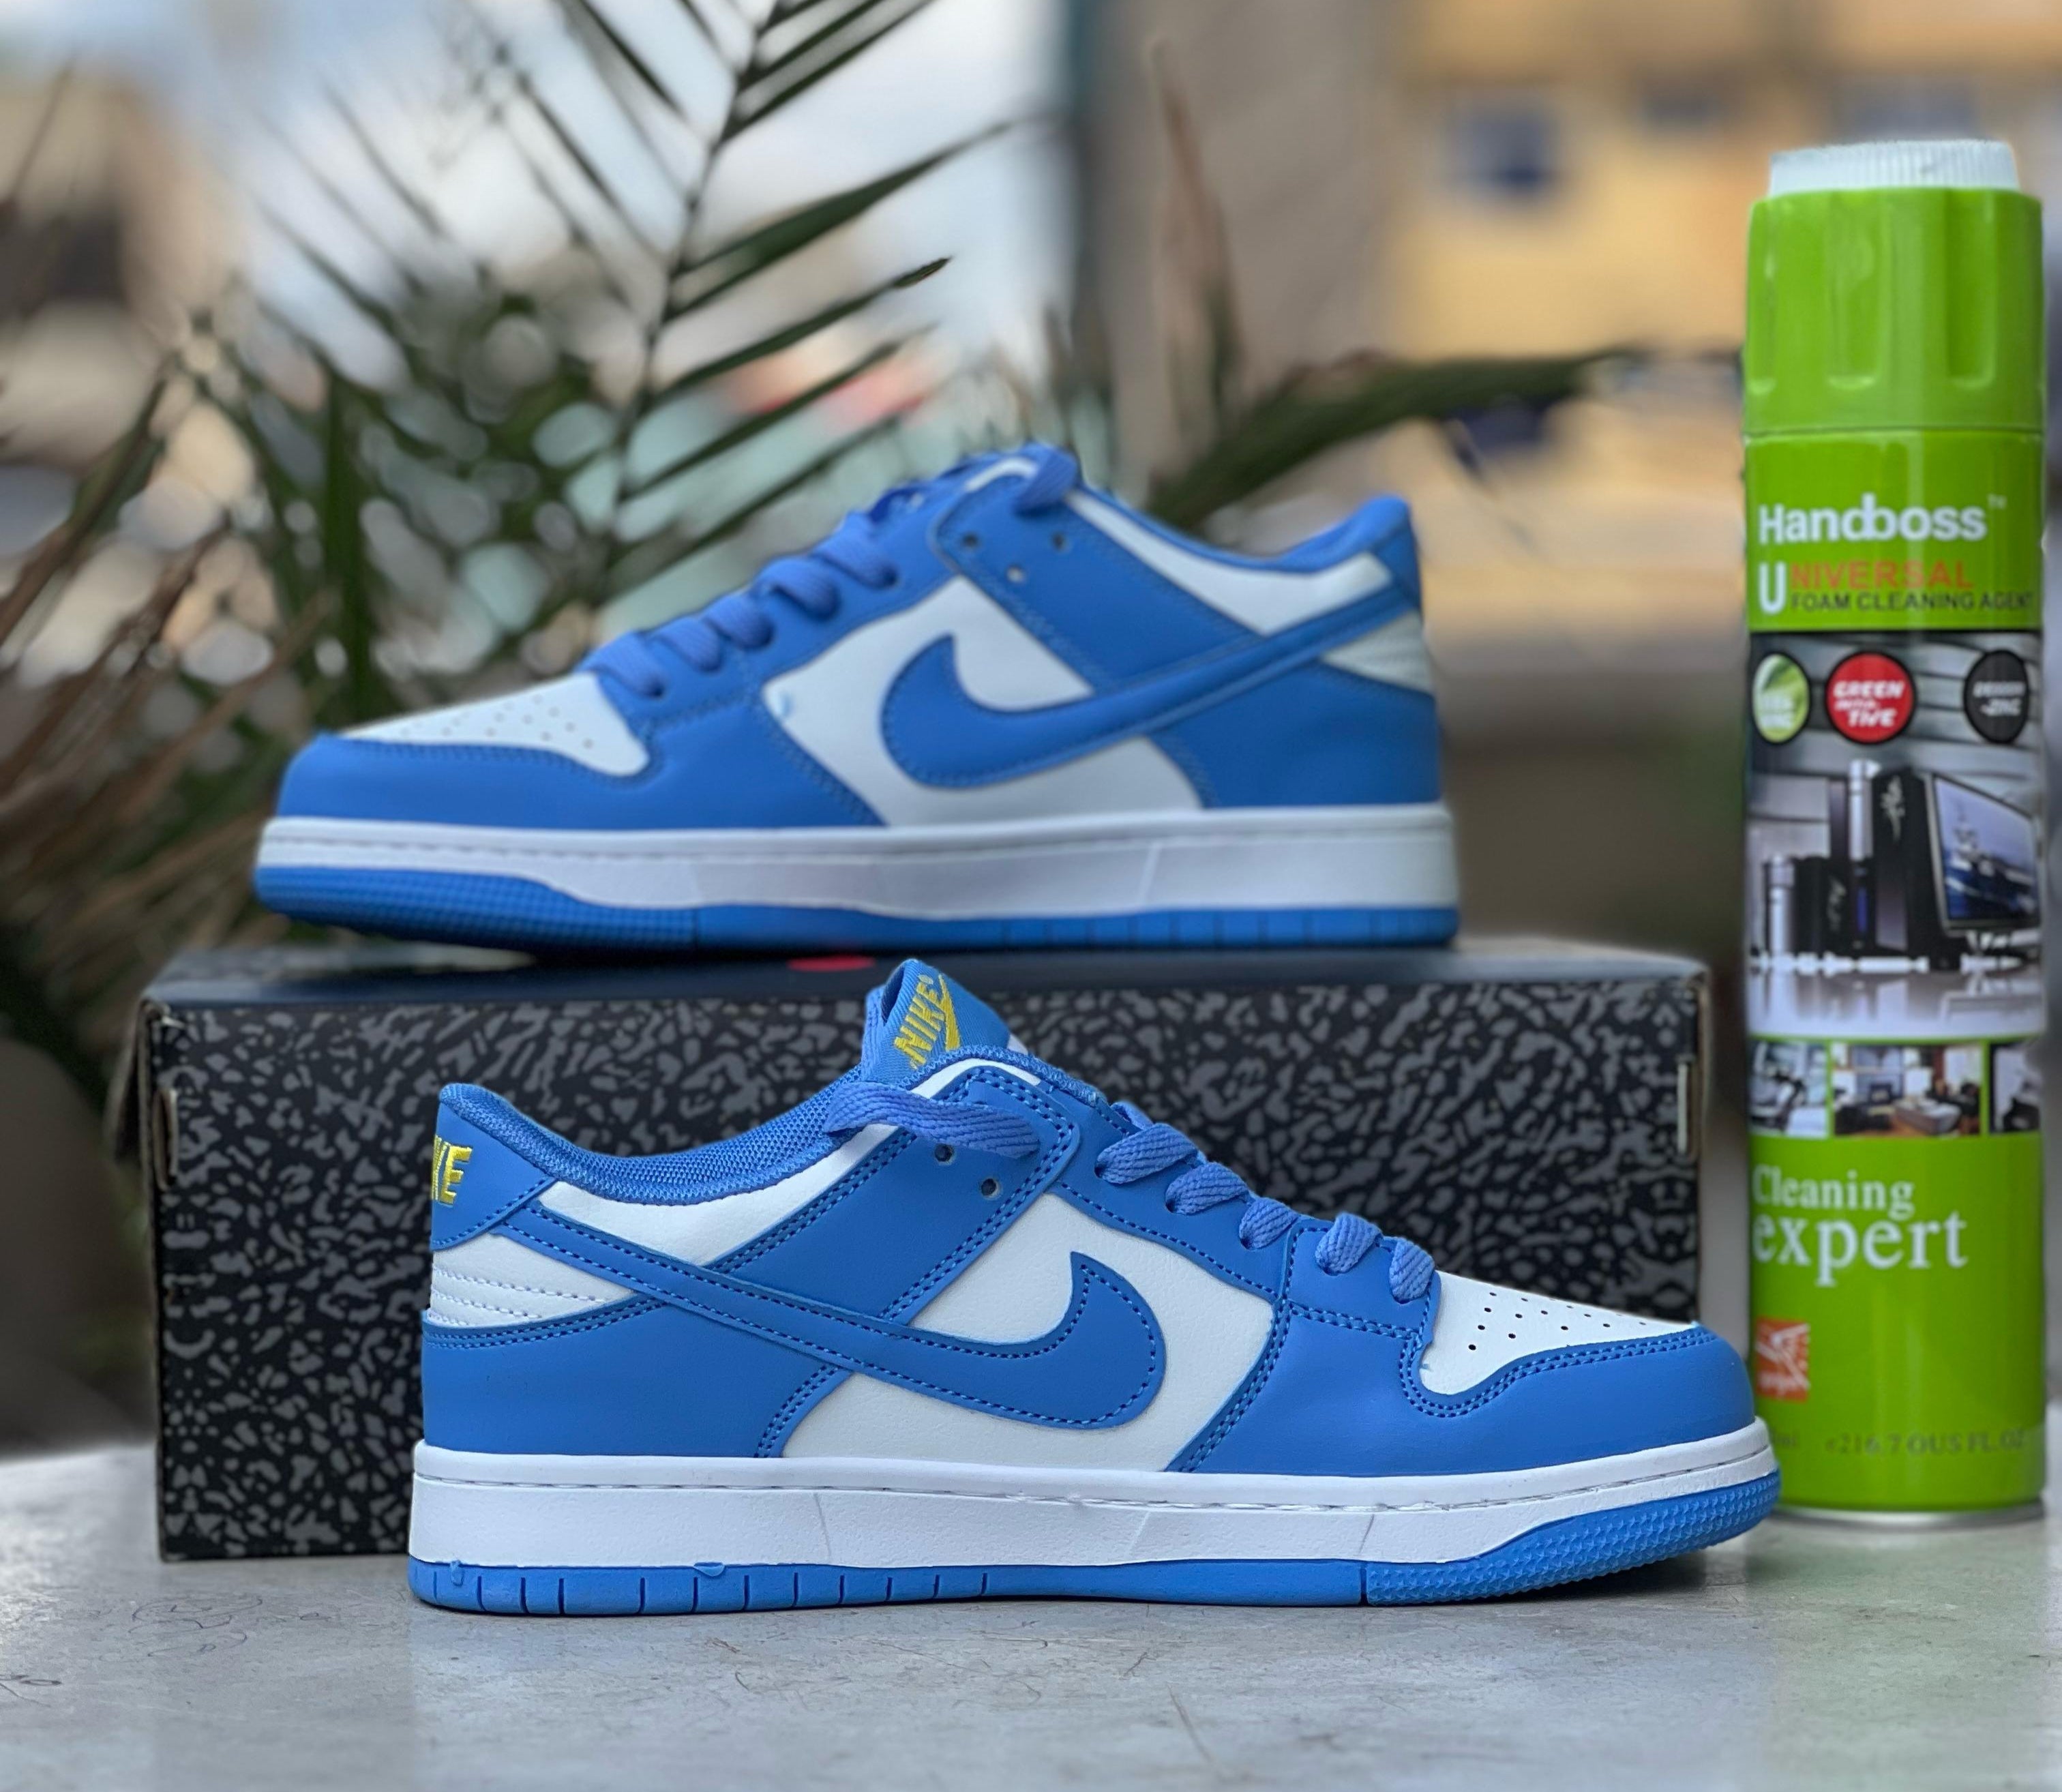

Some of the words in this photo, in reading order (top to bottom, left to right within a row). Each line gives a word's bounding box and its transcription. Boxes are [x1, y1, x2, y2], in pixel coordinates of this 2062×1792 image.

[1759, 492, 1988, 545] Handboss
[1792, 591, 1851, 611] FOAM
[1857, 591, 1975, 611] CLEANING
[1979, 590, 2033, 609] AGENT
[1833, 681, 1904, 698] GREEN
[893, 974, 947, 1071] NIKE
[1752, 1163, 1915, 1221] Cleaning
[1752, 1211, 1969, 1287] expert
